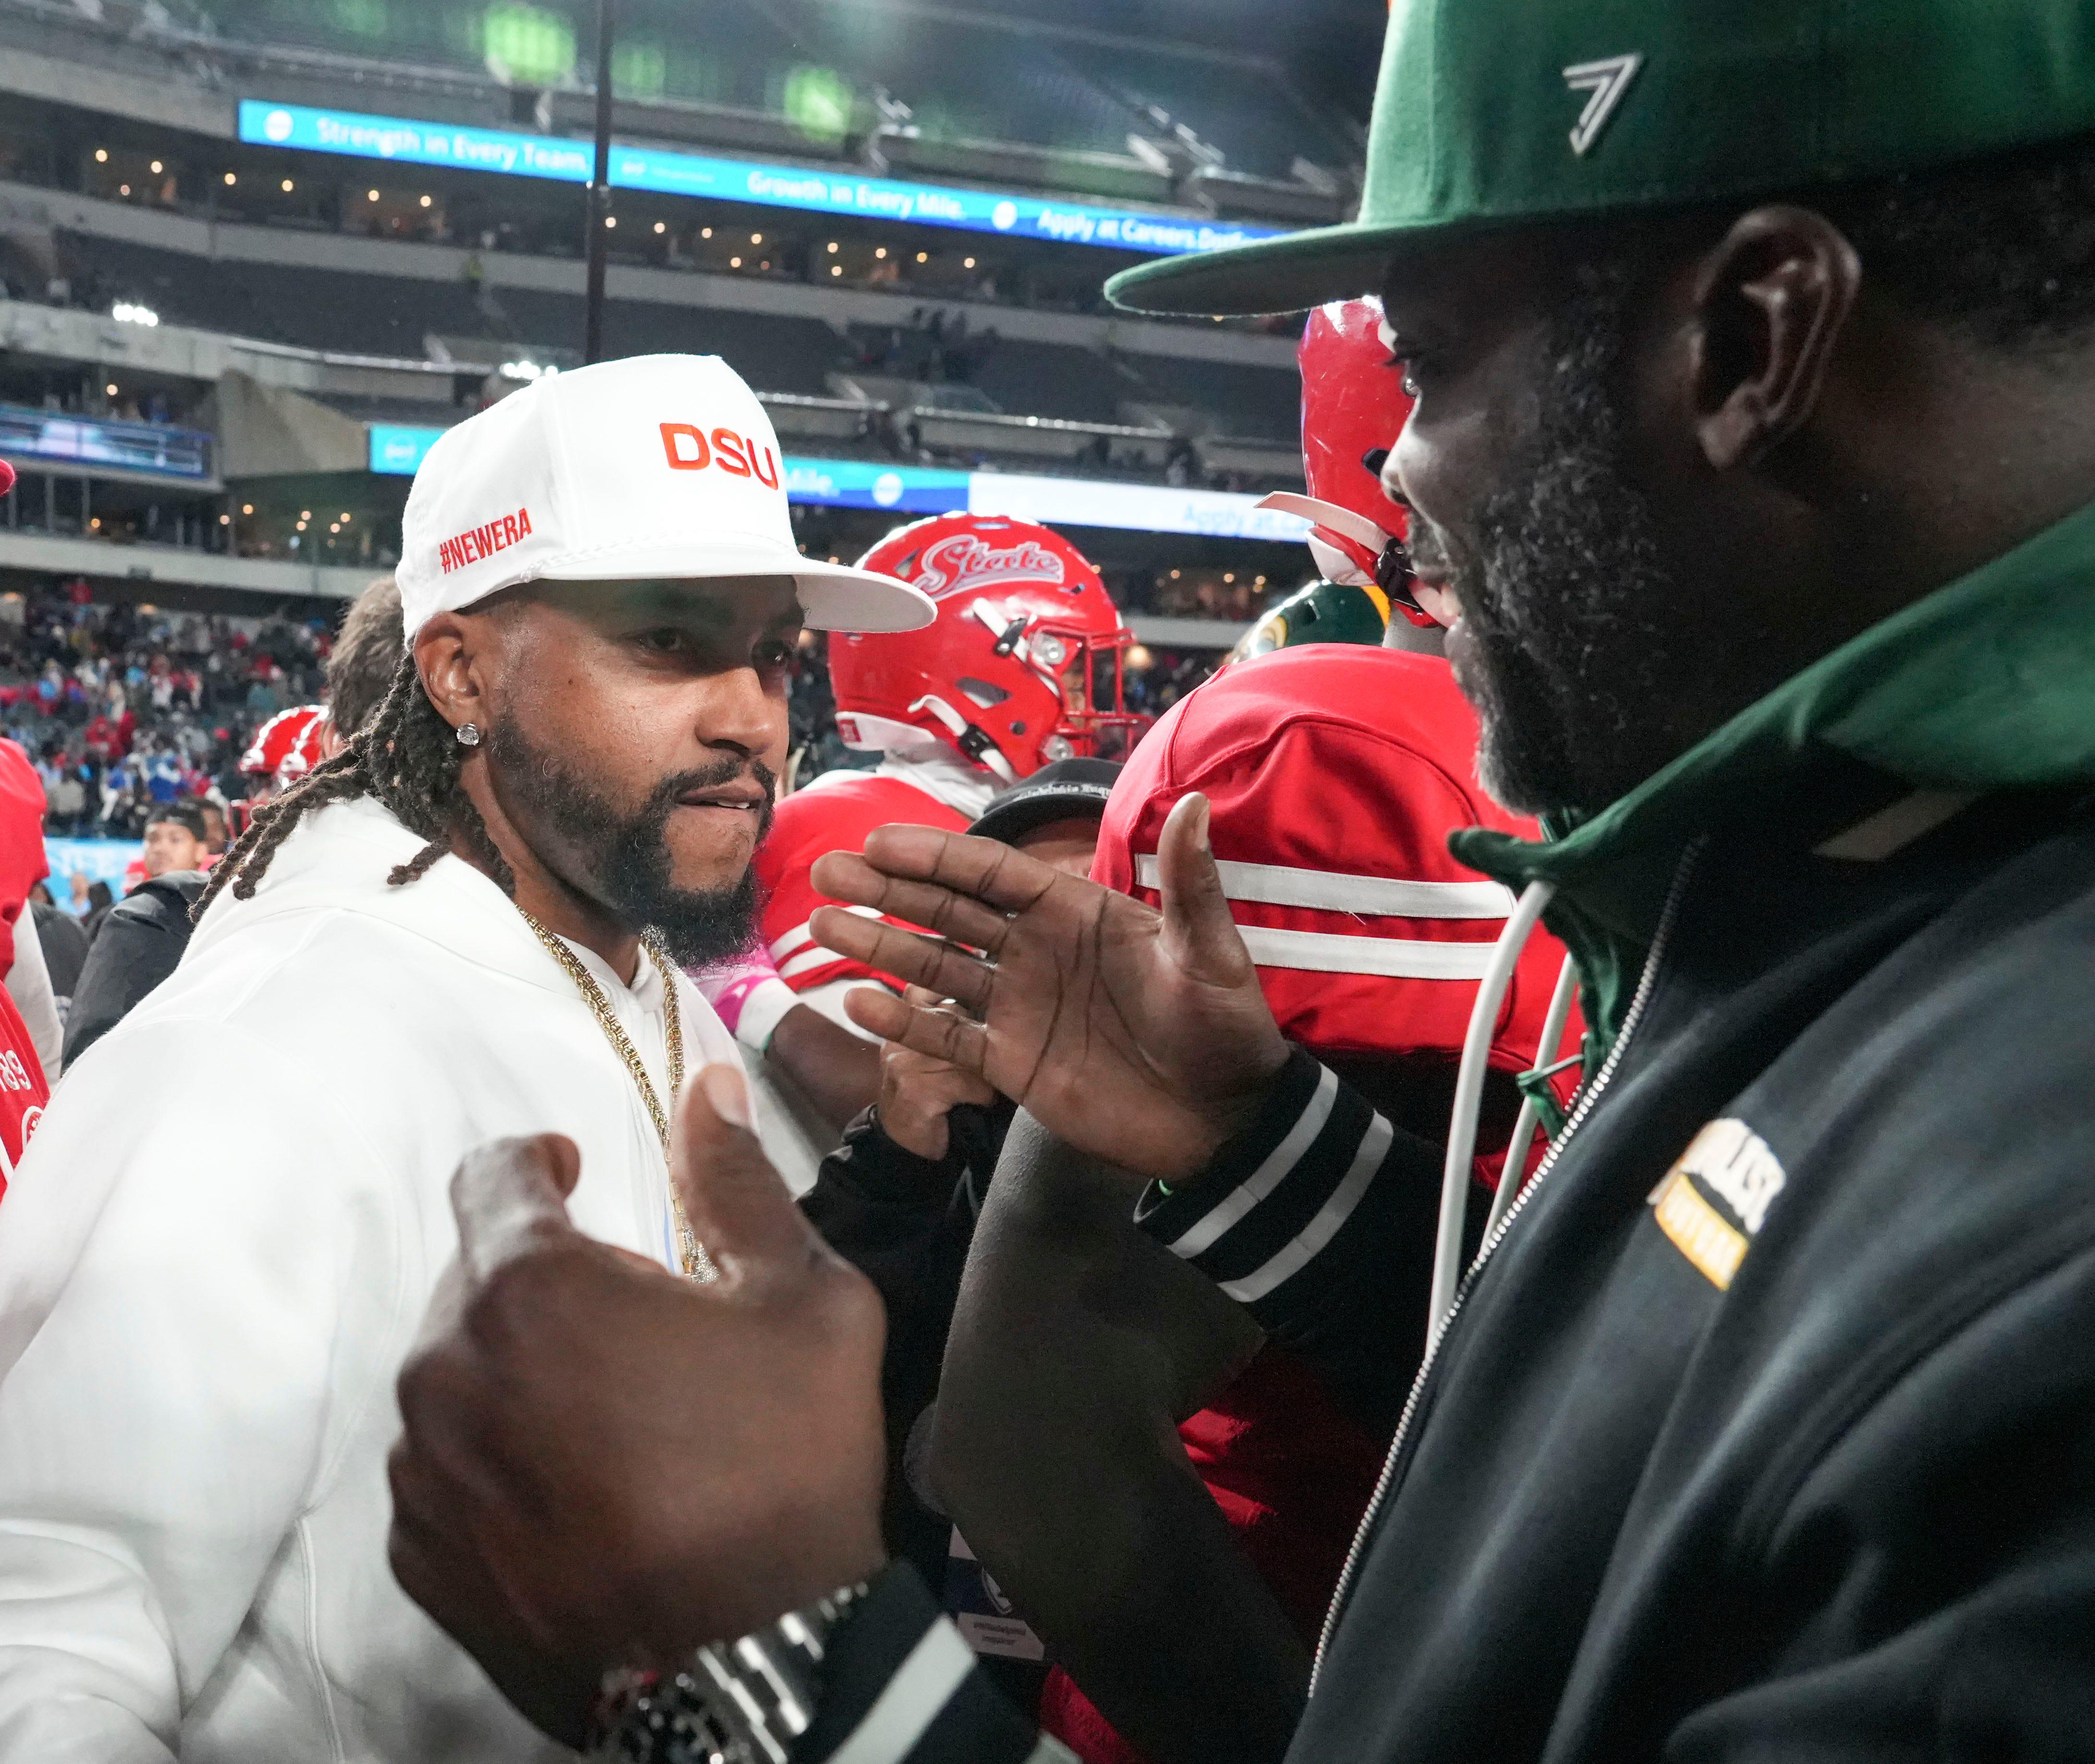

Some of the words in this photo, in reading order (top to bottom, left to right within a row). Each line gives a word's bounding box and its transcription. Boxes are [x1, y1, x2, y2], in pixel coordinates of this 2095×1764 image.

[317, 117, 421, 157] Strength
[425, 134, 449, 155] in
[454, 134, 518, 171] Every
[747, 170, 828, 200] Growth
[830, 182, 854, 203] in
[856, 183, 913, 220] Every
[1037, 209, 1096, 242] Apply
[1096, 218, 1119, 239] at
[660, 423, 778, 490] DSU
[440, 507, 532, 574] #NEWERA
[1182, 504, 1246, 532] Apply
[911, 534, 1065, 603] State
